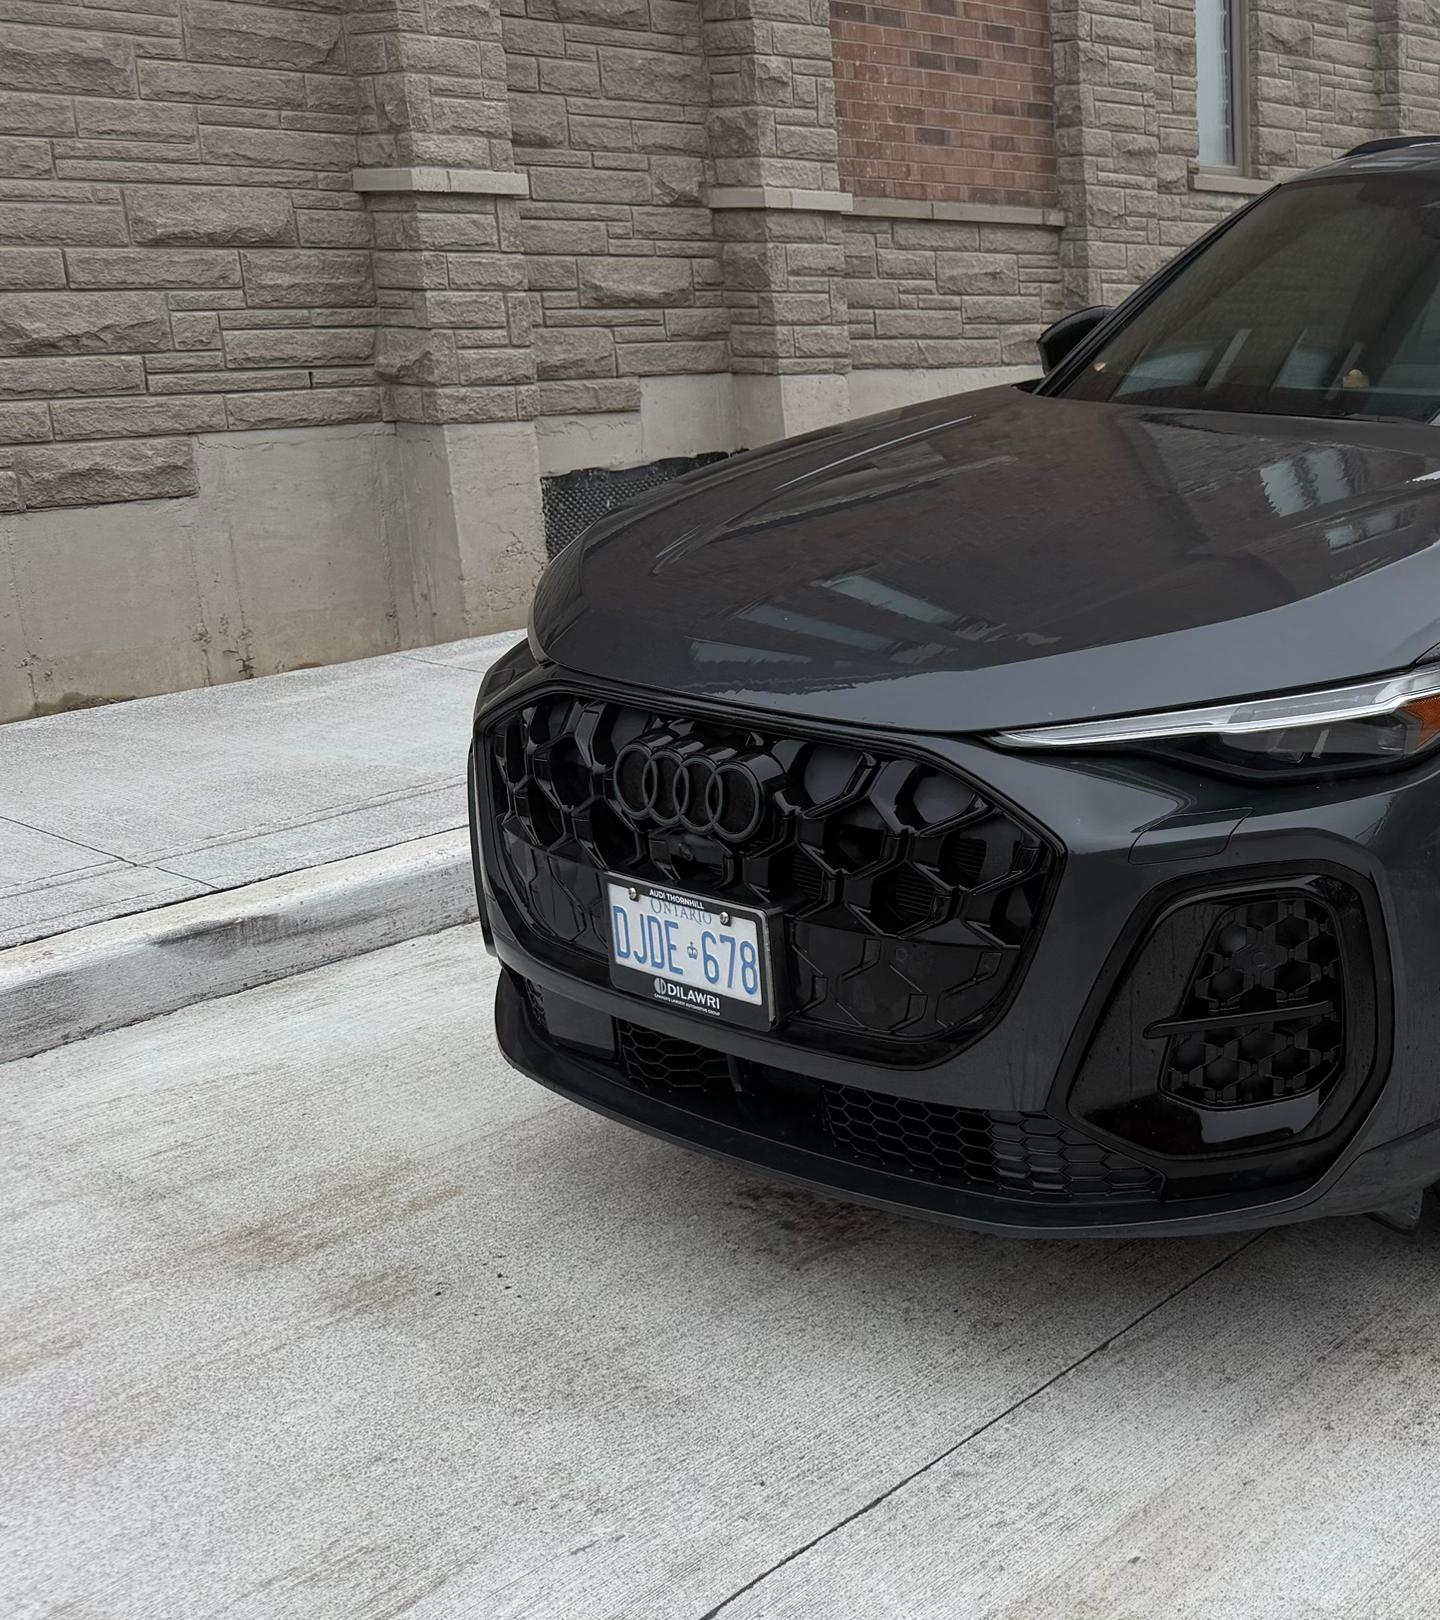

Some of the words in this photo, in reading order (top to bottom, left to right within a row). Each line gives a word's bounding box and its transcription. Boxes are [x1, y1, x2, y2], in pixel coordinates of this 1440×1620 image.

[649, 889, 666, 900] AUDI
[666, 893, 705, 910] THORNHILL
[650, 897, 713, 926] ONTARIO
[612, 905, 684, 975] DJDE
[701, 930, 758, 996] 678
[667, 983, 721, 1010] DILAWRI
